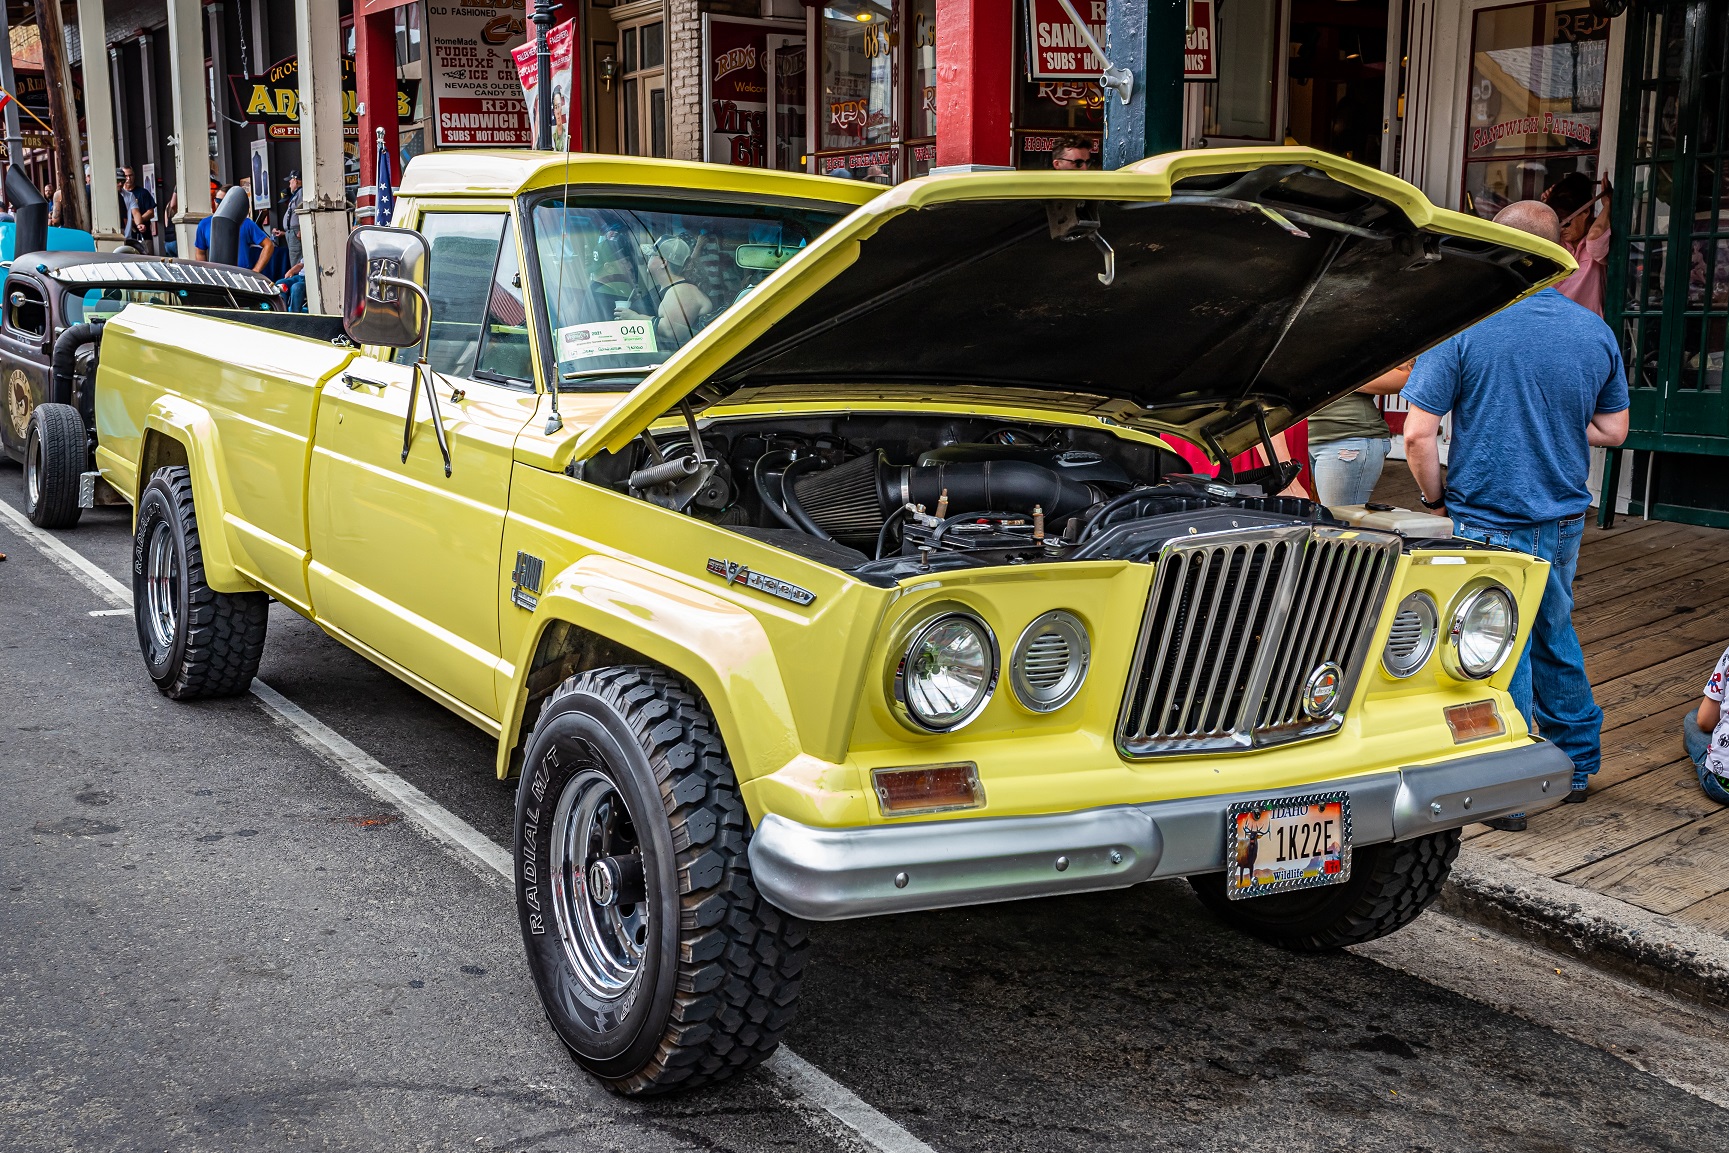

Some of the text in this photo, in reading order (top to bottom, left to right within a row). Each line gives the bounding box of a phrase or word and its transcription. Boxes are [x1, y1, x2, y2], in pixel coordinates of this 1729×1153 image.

[430, 7, 497, 17] OLD FASHIONED
[434, 37, 477, 46] HomeMade
[864, 23, 879, 59] 68
[435, 46, 477, 57] FUDGE
[441, 58, 493, 68] DELUXE
[1046, 51, 1077, 70] SUBS
[469, 70, 488, 80] ICE
[481, 100, 528, 112] REDS
[441, 113, 518, 128] SANDWICH
[831, 98, 868, 129] REDS
[447, 131, 470, 141] SUBS
[476, 131, 492, 141] HOT
[493, 131, 515, 141] DOGS
[1472, 112, 1591, 152] SANDWICH PARLOR
[826, 157, 846, 170] ICE
[849, 152, 890, 167] CREAM
[620, 325, 645, 336] 040
[1271, 805, 1308, 820] IDAHO
[523, 744, 560, 935] RADIAL M/T
[1276, 820, 1334, 862] 1K22E
[1273, 868, 1304, 881] Wildlife
